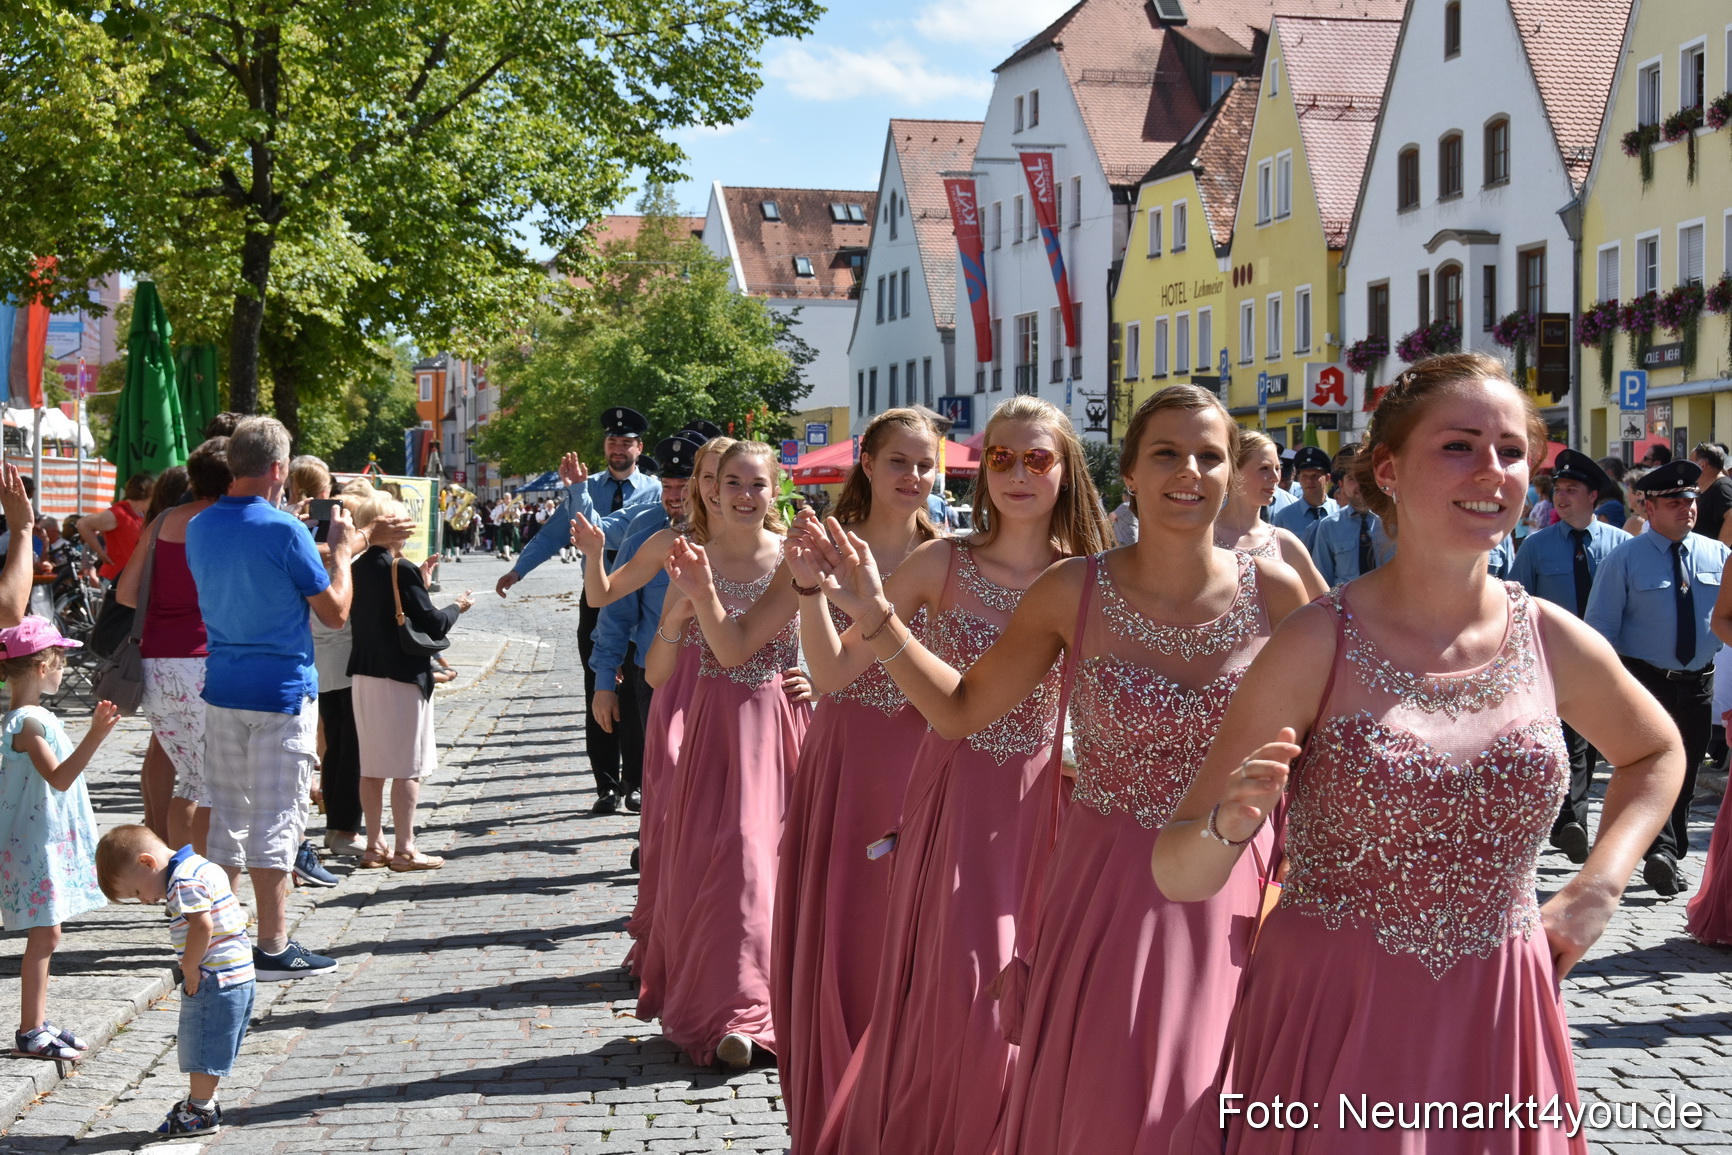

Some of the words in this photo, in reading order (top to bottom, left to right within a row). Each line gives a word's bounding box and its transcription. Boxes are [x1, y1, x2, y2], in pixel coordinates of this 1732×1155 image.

[1161, 282, 1187, 307] HOTEL
[1194, 277, 1224, 299] Lehmeier
[1665, 348, 1680, 361] MEHR
[1625, 375, 1640, 406] P
